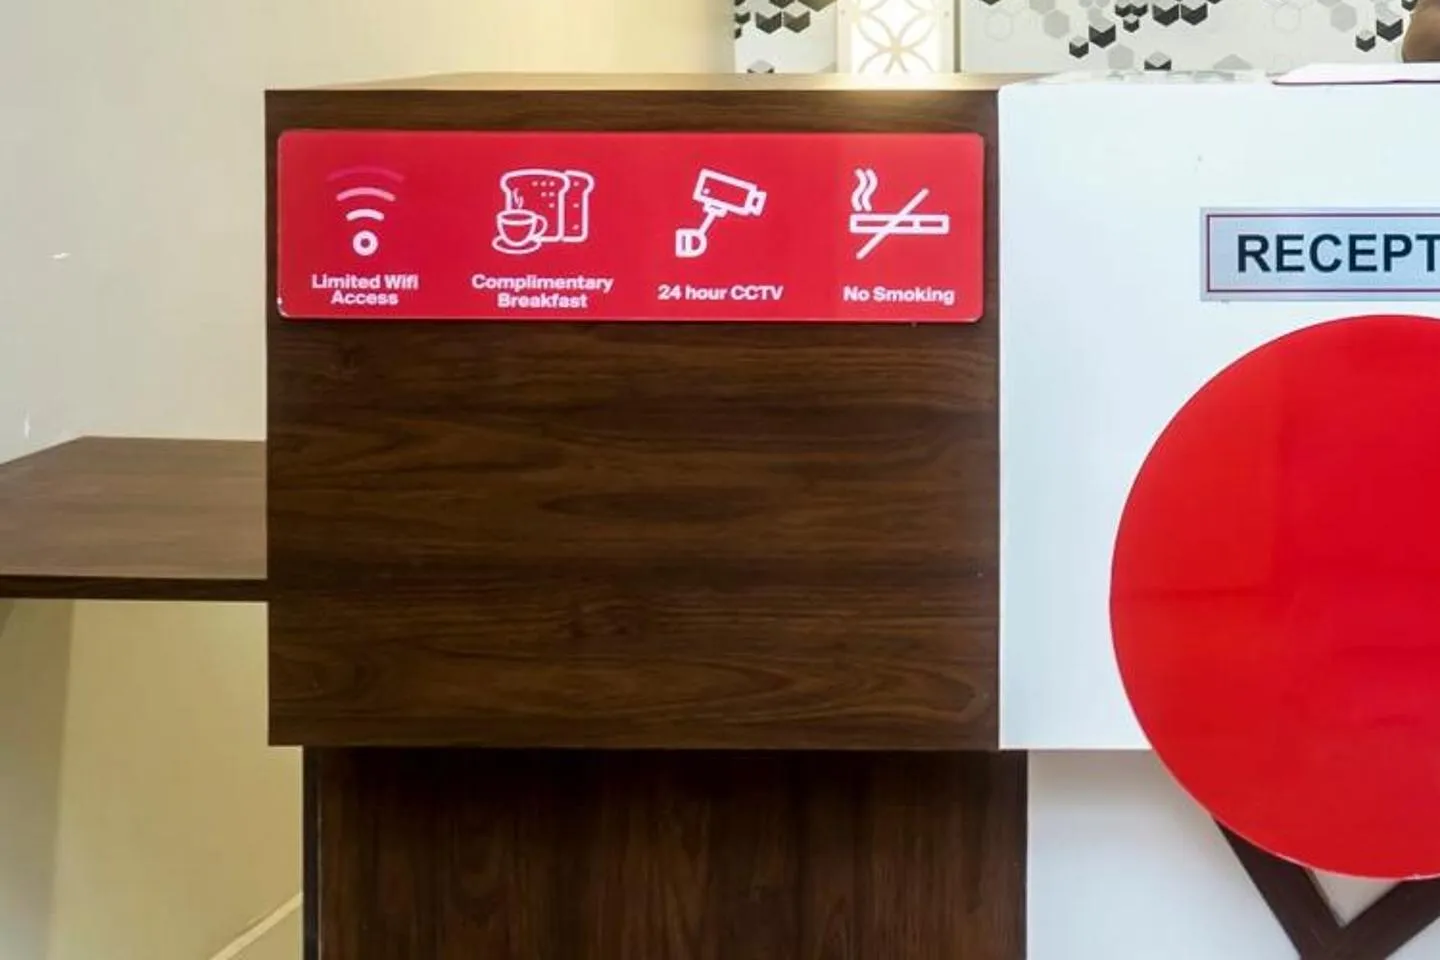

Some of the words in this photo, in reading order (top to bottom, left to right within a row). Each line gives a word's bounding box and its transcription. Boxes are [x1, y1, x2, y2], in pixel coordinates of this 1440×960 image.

[312, 274, 381, 290] Limited
[384, 274, 419, 290] Wifi
[471, 274, 614, 296] Complimentary
[331, 290, 399, 305] Access
[497, 292, 588, 308] Breakfast
[658, 284, 681, 300] 24
[684, 285, 728, 301] hour
[730, 285, 784, 301] CCTV
[843, 285, 870, 302] No
[872, 285, 955, 306] Smoking
